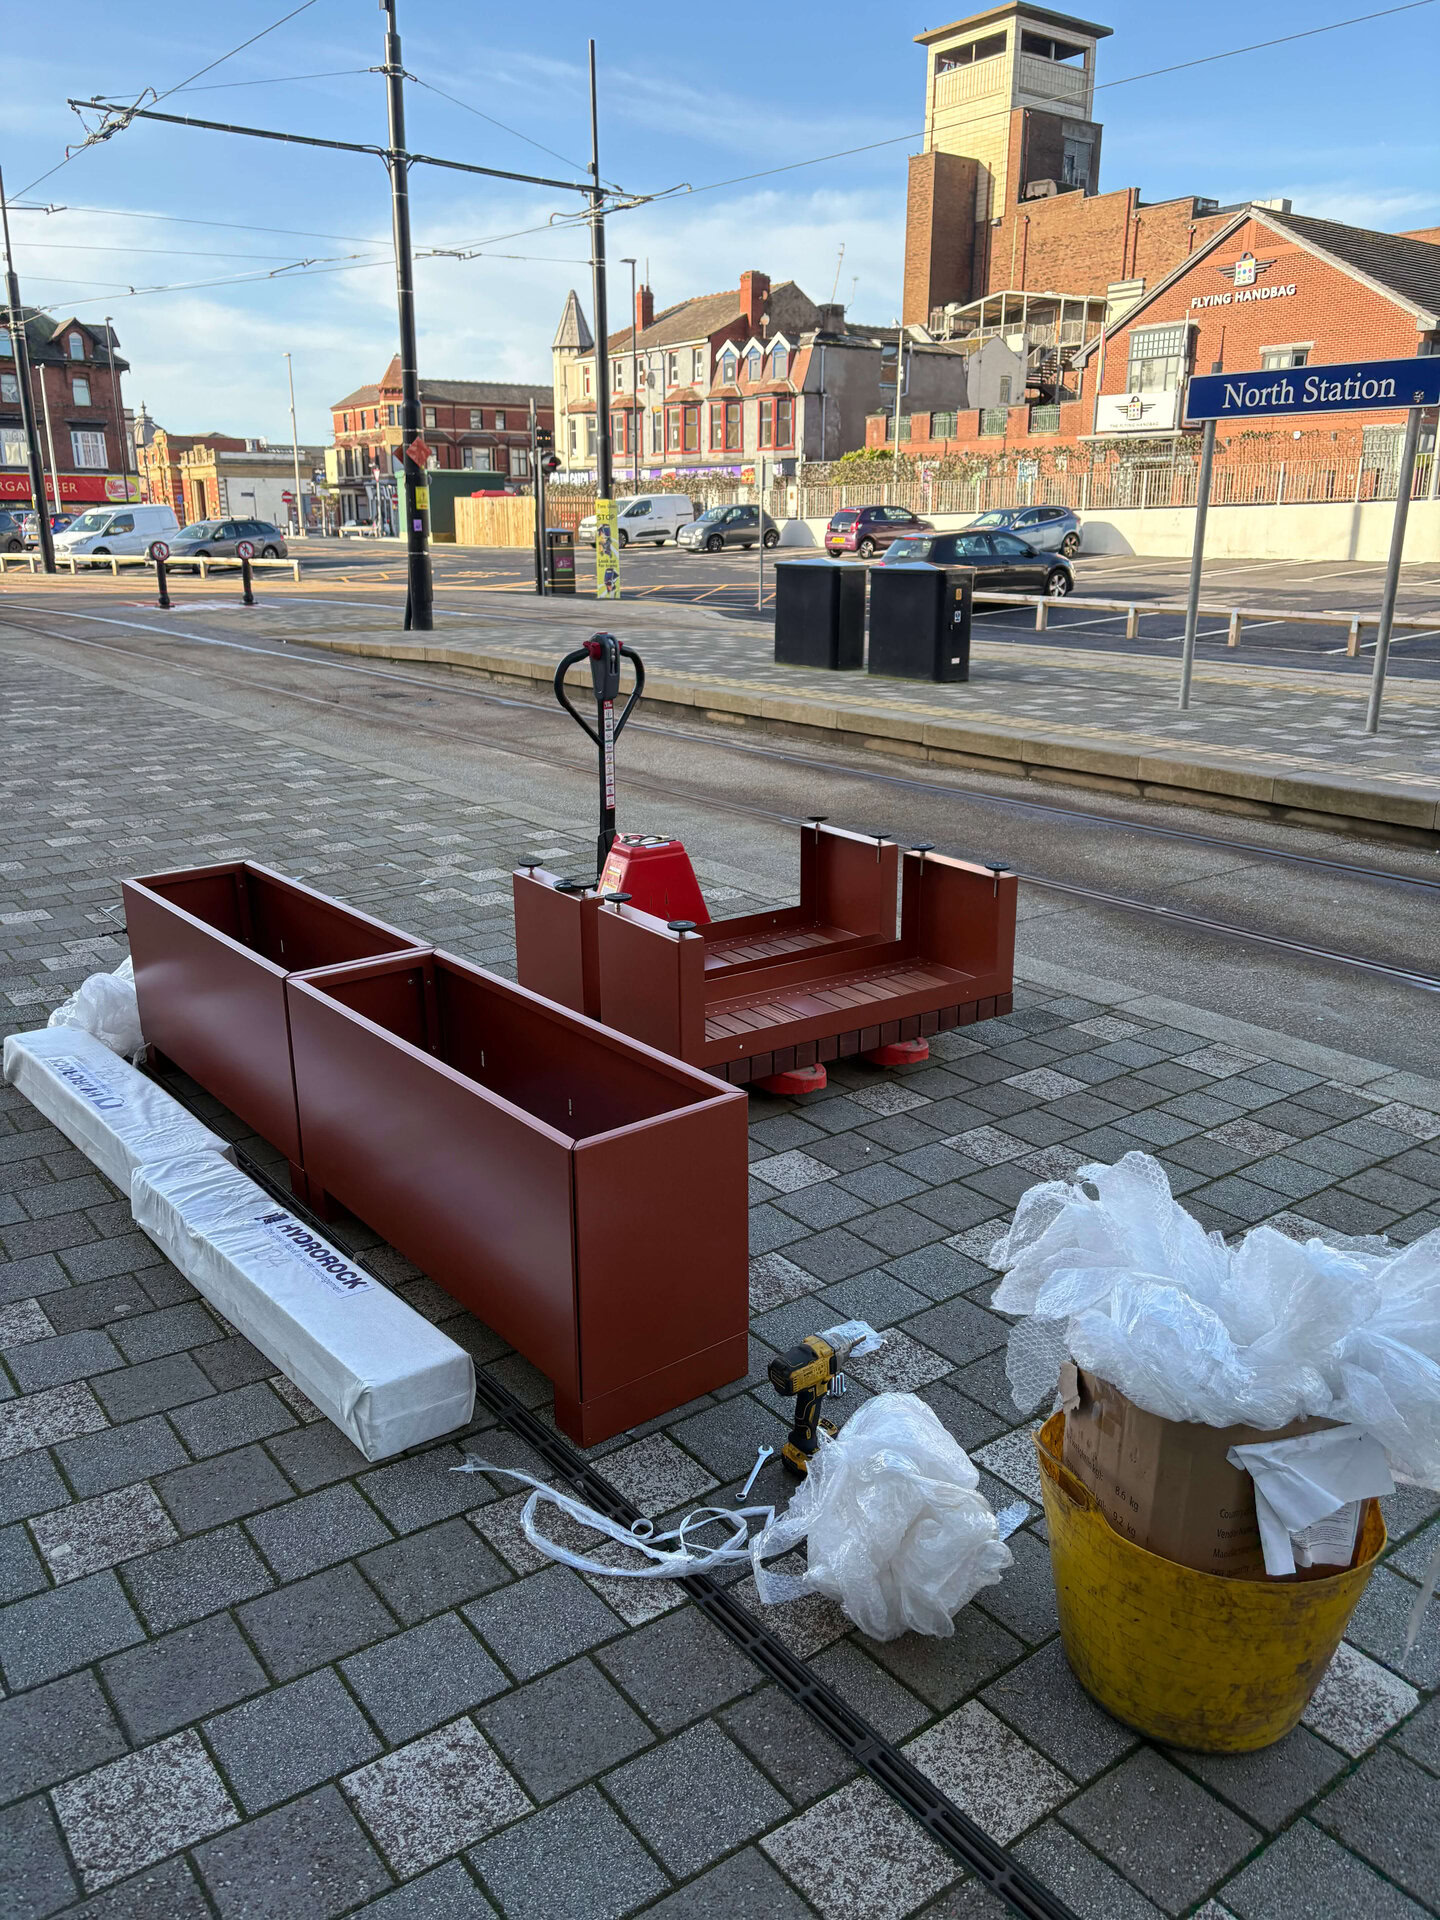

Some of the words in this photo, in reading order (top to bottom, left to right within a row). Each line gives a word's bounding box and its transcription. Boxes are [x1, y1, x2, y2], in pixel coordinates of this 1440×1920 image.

[1191, 293, 1233, 309] FLYING
[1234, 284, 1297, 303] HANDBAG
[1222, 378, 1294, 409] North
[1302, 372, 1396, 404] Station
[0, 481, 30, 492] RGAI
[276, 1223, 368, 1290] HYDROROCK
[1129, 1496, 1139, 1512] kg
[1113, 1511, 1123, 1527] 9.2
[1127, 1522, 1136, 1538] kg
